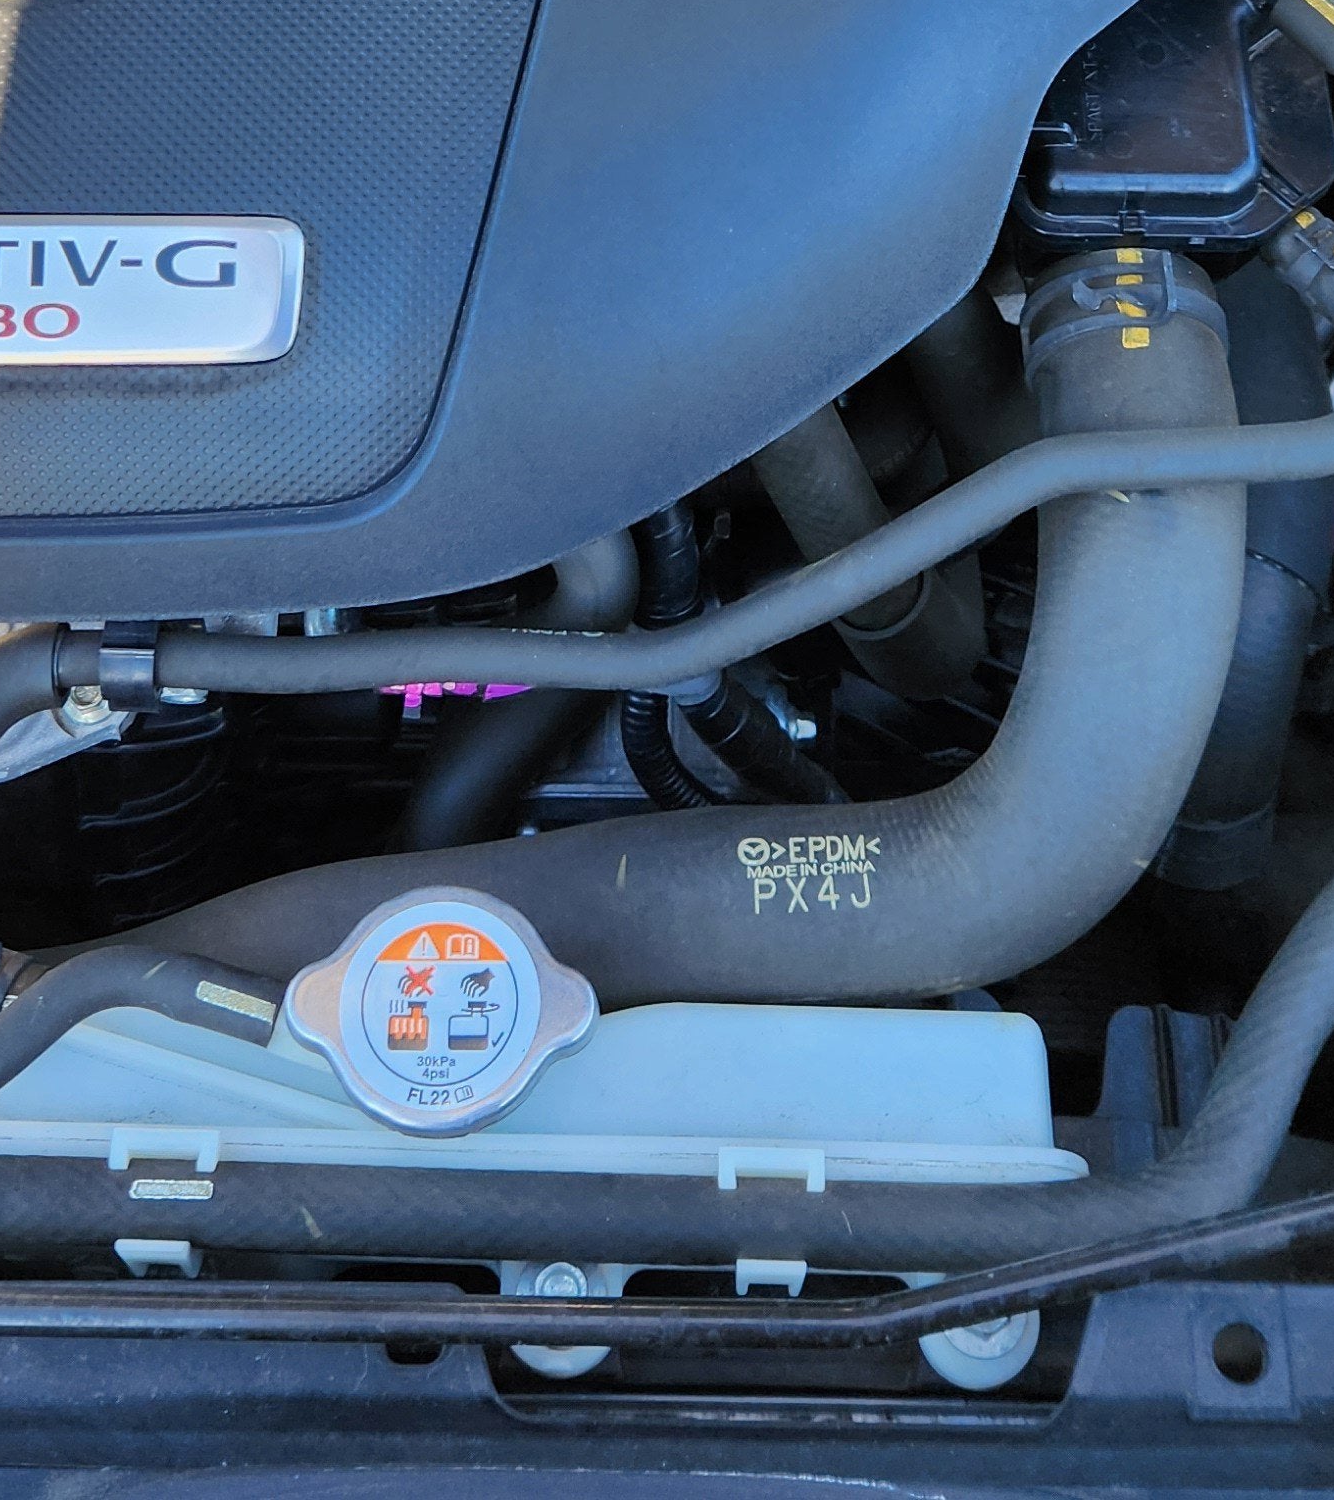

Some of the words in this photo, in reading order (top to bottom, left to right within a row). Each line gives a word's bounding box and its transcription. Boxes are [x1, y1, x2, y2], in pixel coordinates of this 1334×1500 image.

[746, 863, 798, 879] MADE
[800, 863, 818, 877] IN
[820, 860, 877, 877] CHINA
[417, 1056, 456, 1068] 30kPa
[422, 1067, 450, 1081] 4psi
[406, 1086, 452, 1106] FL22
